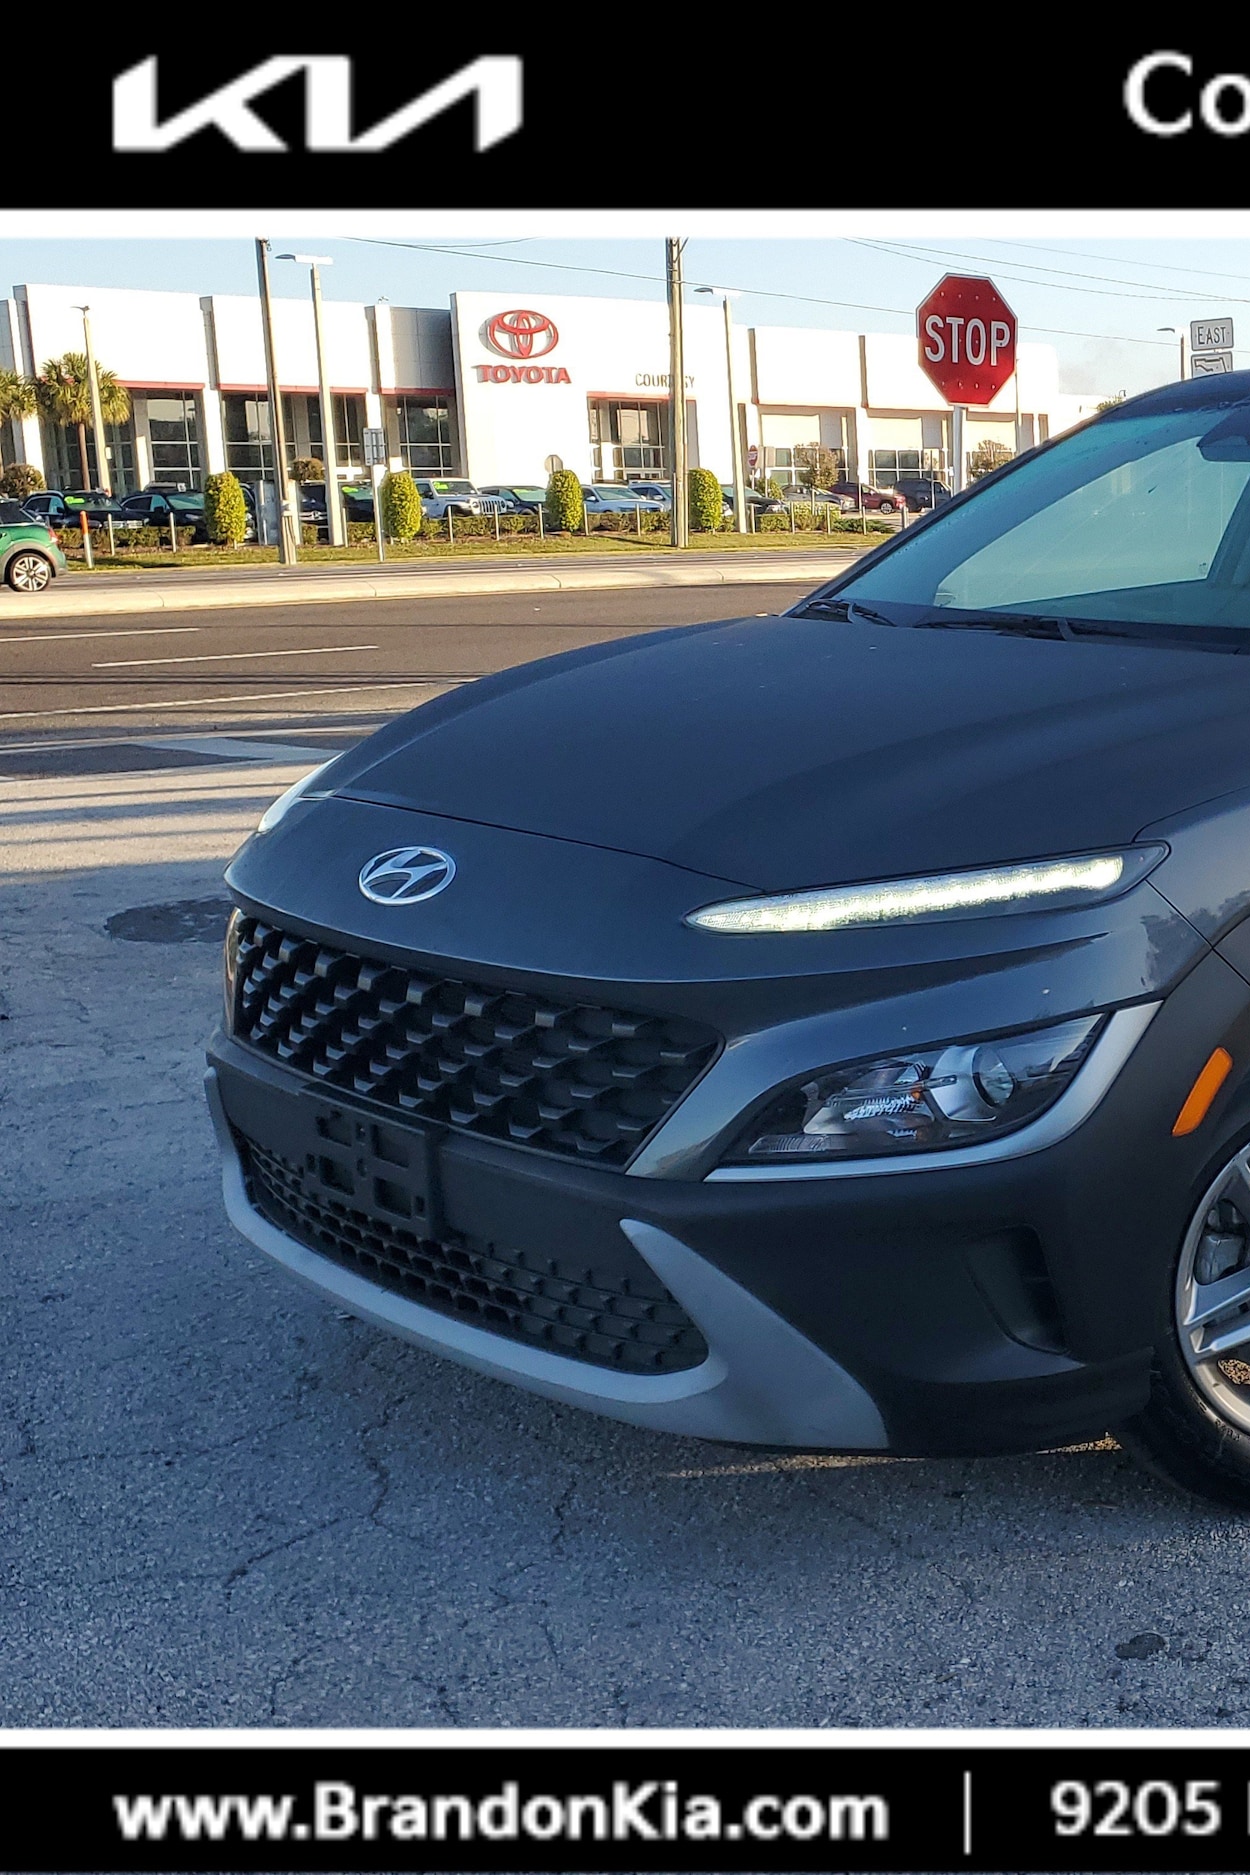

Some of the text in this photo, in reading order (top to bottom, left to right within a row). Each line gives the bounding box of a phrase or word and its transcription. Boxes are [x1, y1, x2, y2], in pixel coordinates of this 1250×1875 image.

[924, 314, 1011, 367] STOP
[1197, 326, 1226, 345] EAST
[475, 364, 572, 384] TOYOTA
[635, 373, 695, 389] COURSY
